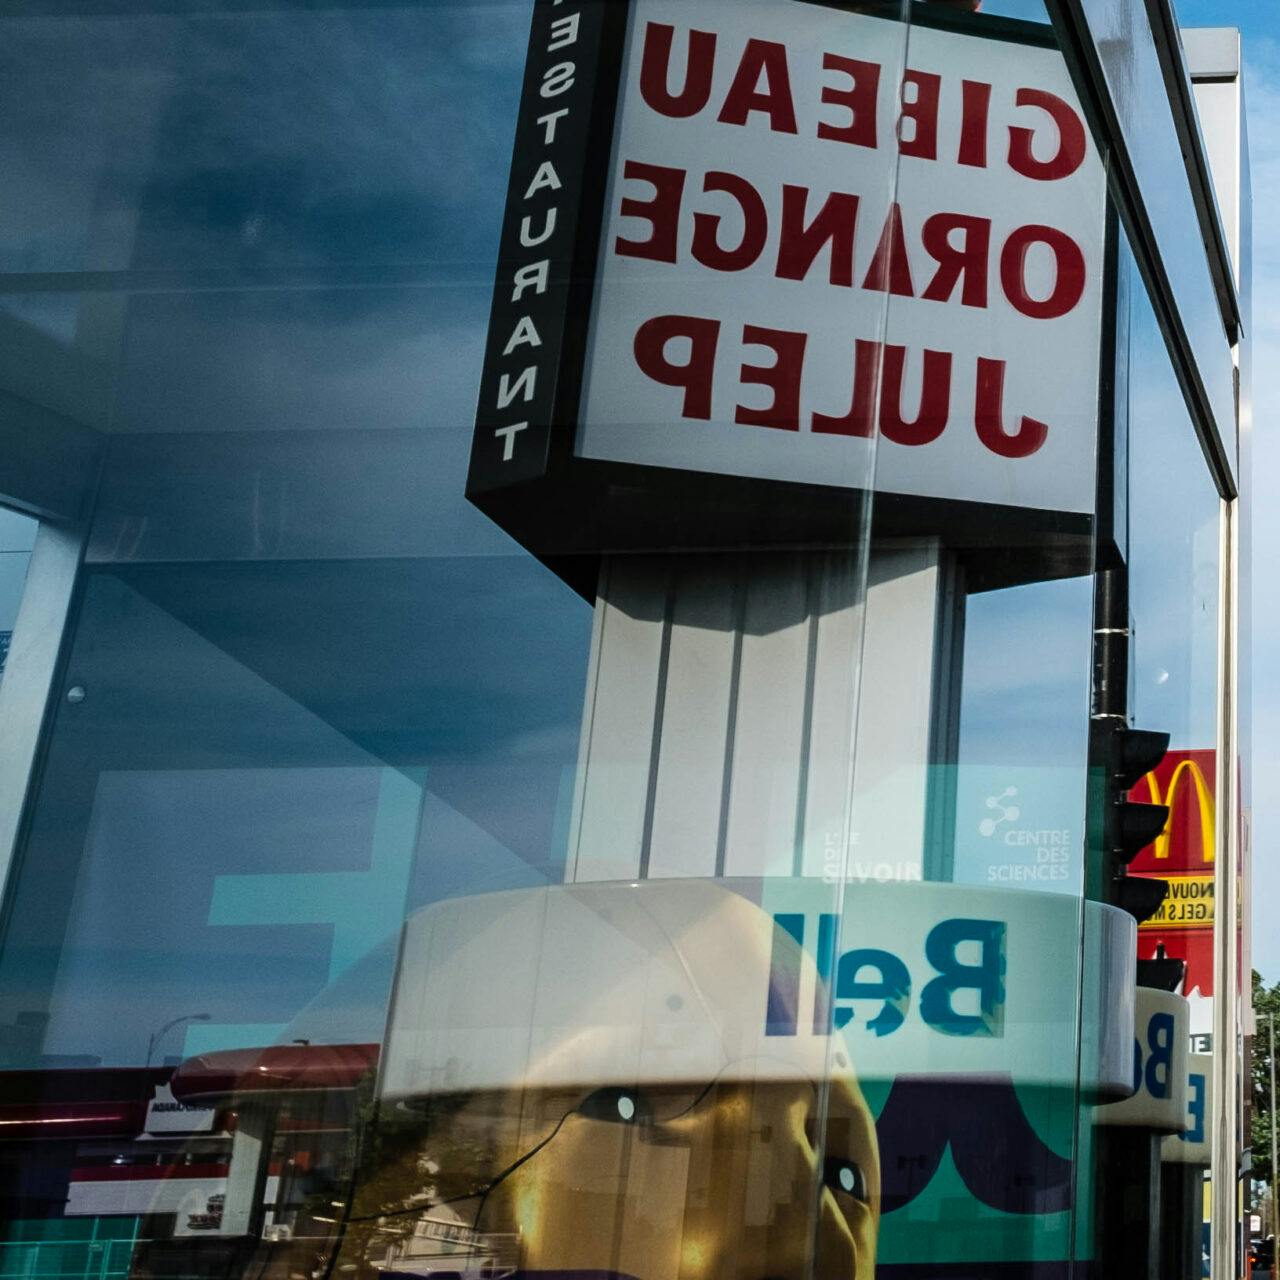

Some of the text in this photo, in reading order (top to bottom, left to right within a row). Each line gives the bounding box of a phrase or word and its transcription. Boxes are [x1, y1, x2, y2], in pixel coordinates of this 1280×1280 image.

[1004, 830, 1070, 846] CENTRE
[1036, 847, 1070, 863] DES
[987, 864, 1070, 881] SCIENCES
